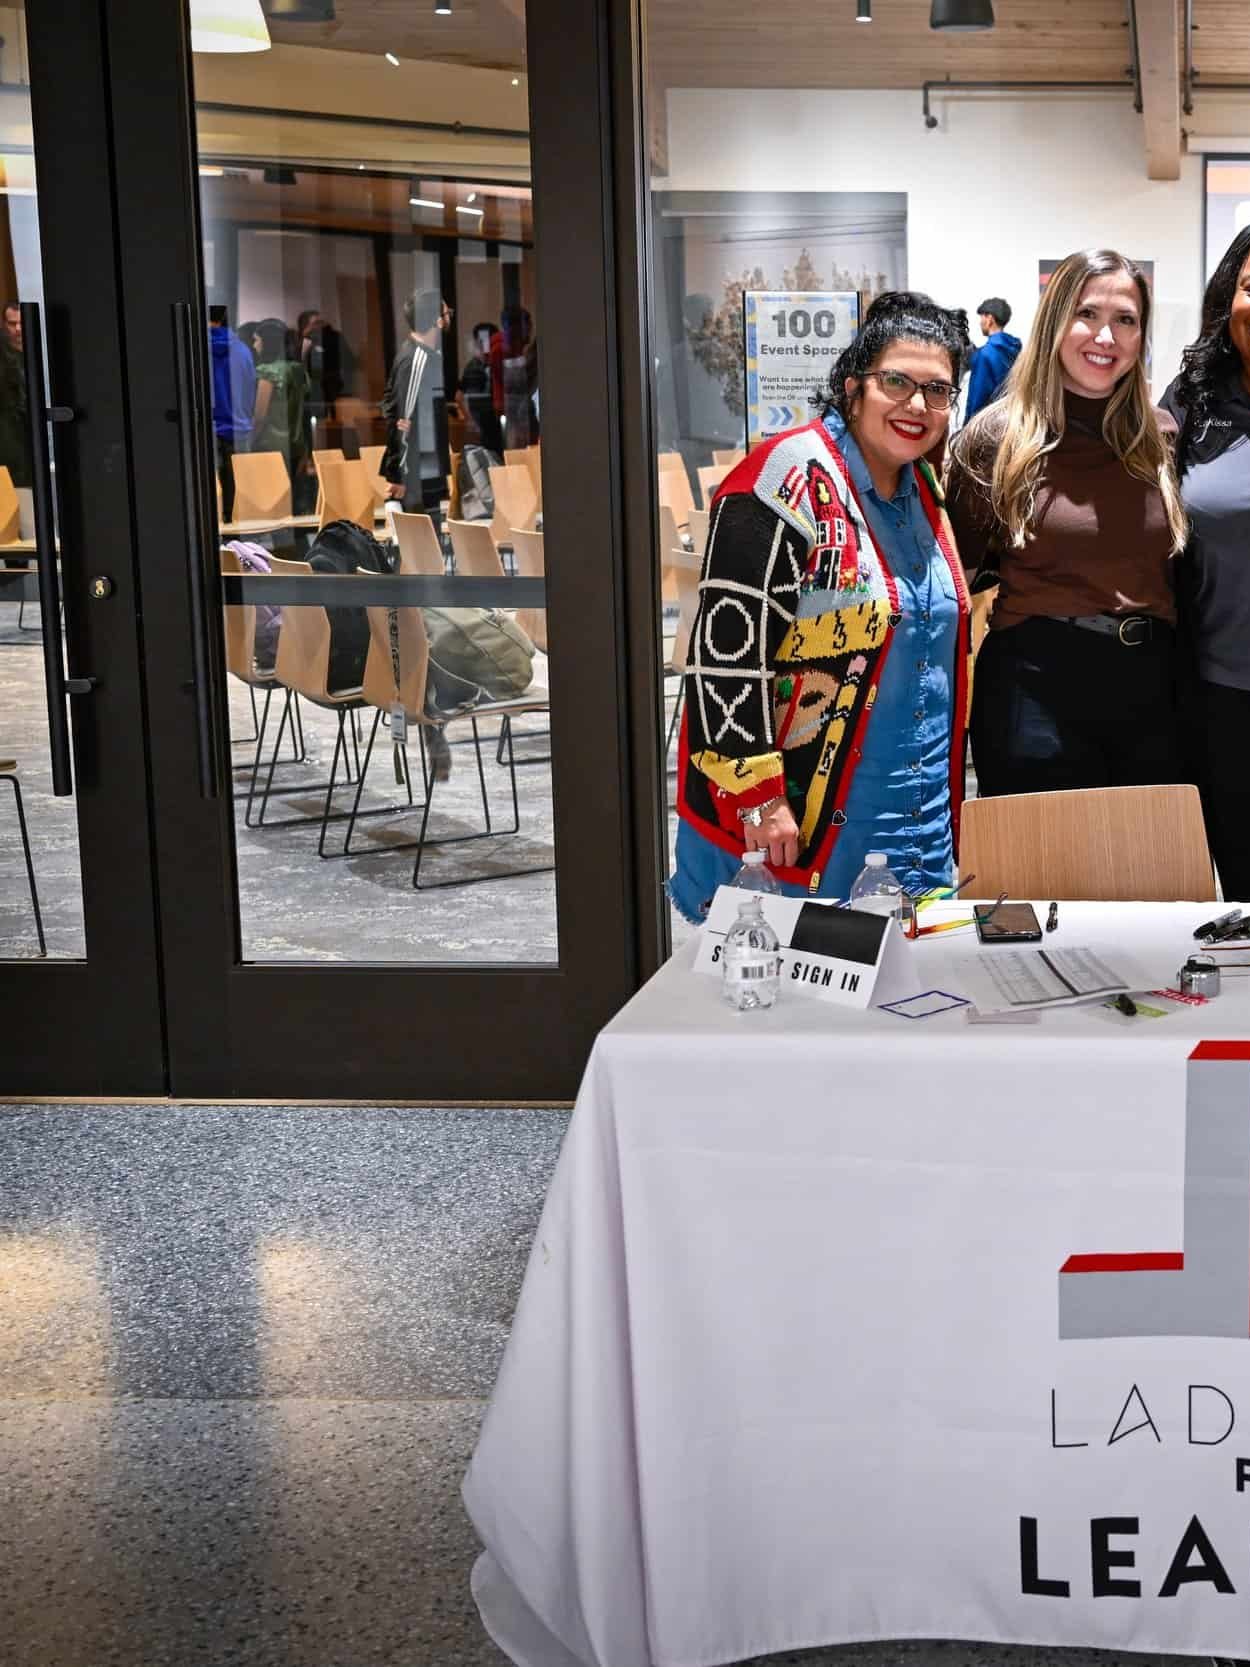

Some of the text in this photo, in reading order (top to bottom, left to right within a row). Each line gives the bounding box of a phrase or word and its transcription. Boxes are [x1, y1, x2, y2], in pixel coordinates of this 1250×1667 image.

[772, 310, 836, 338] 100
[761, 344, 800, 355] Event
[791, 962, 860, 993] SIGN IN
